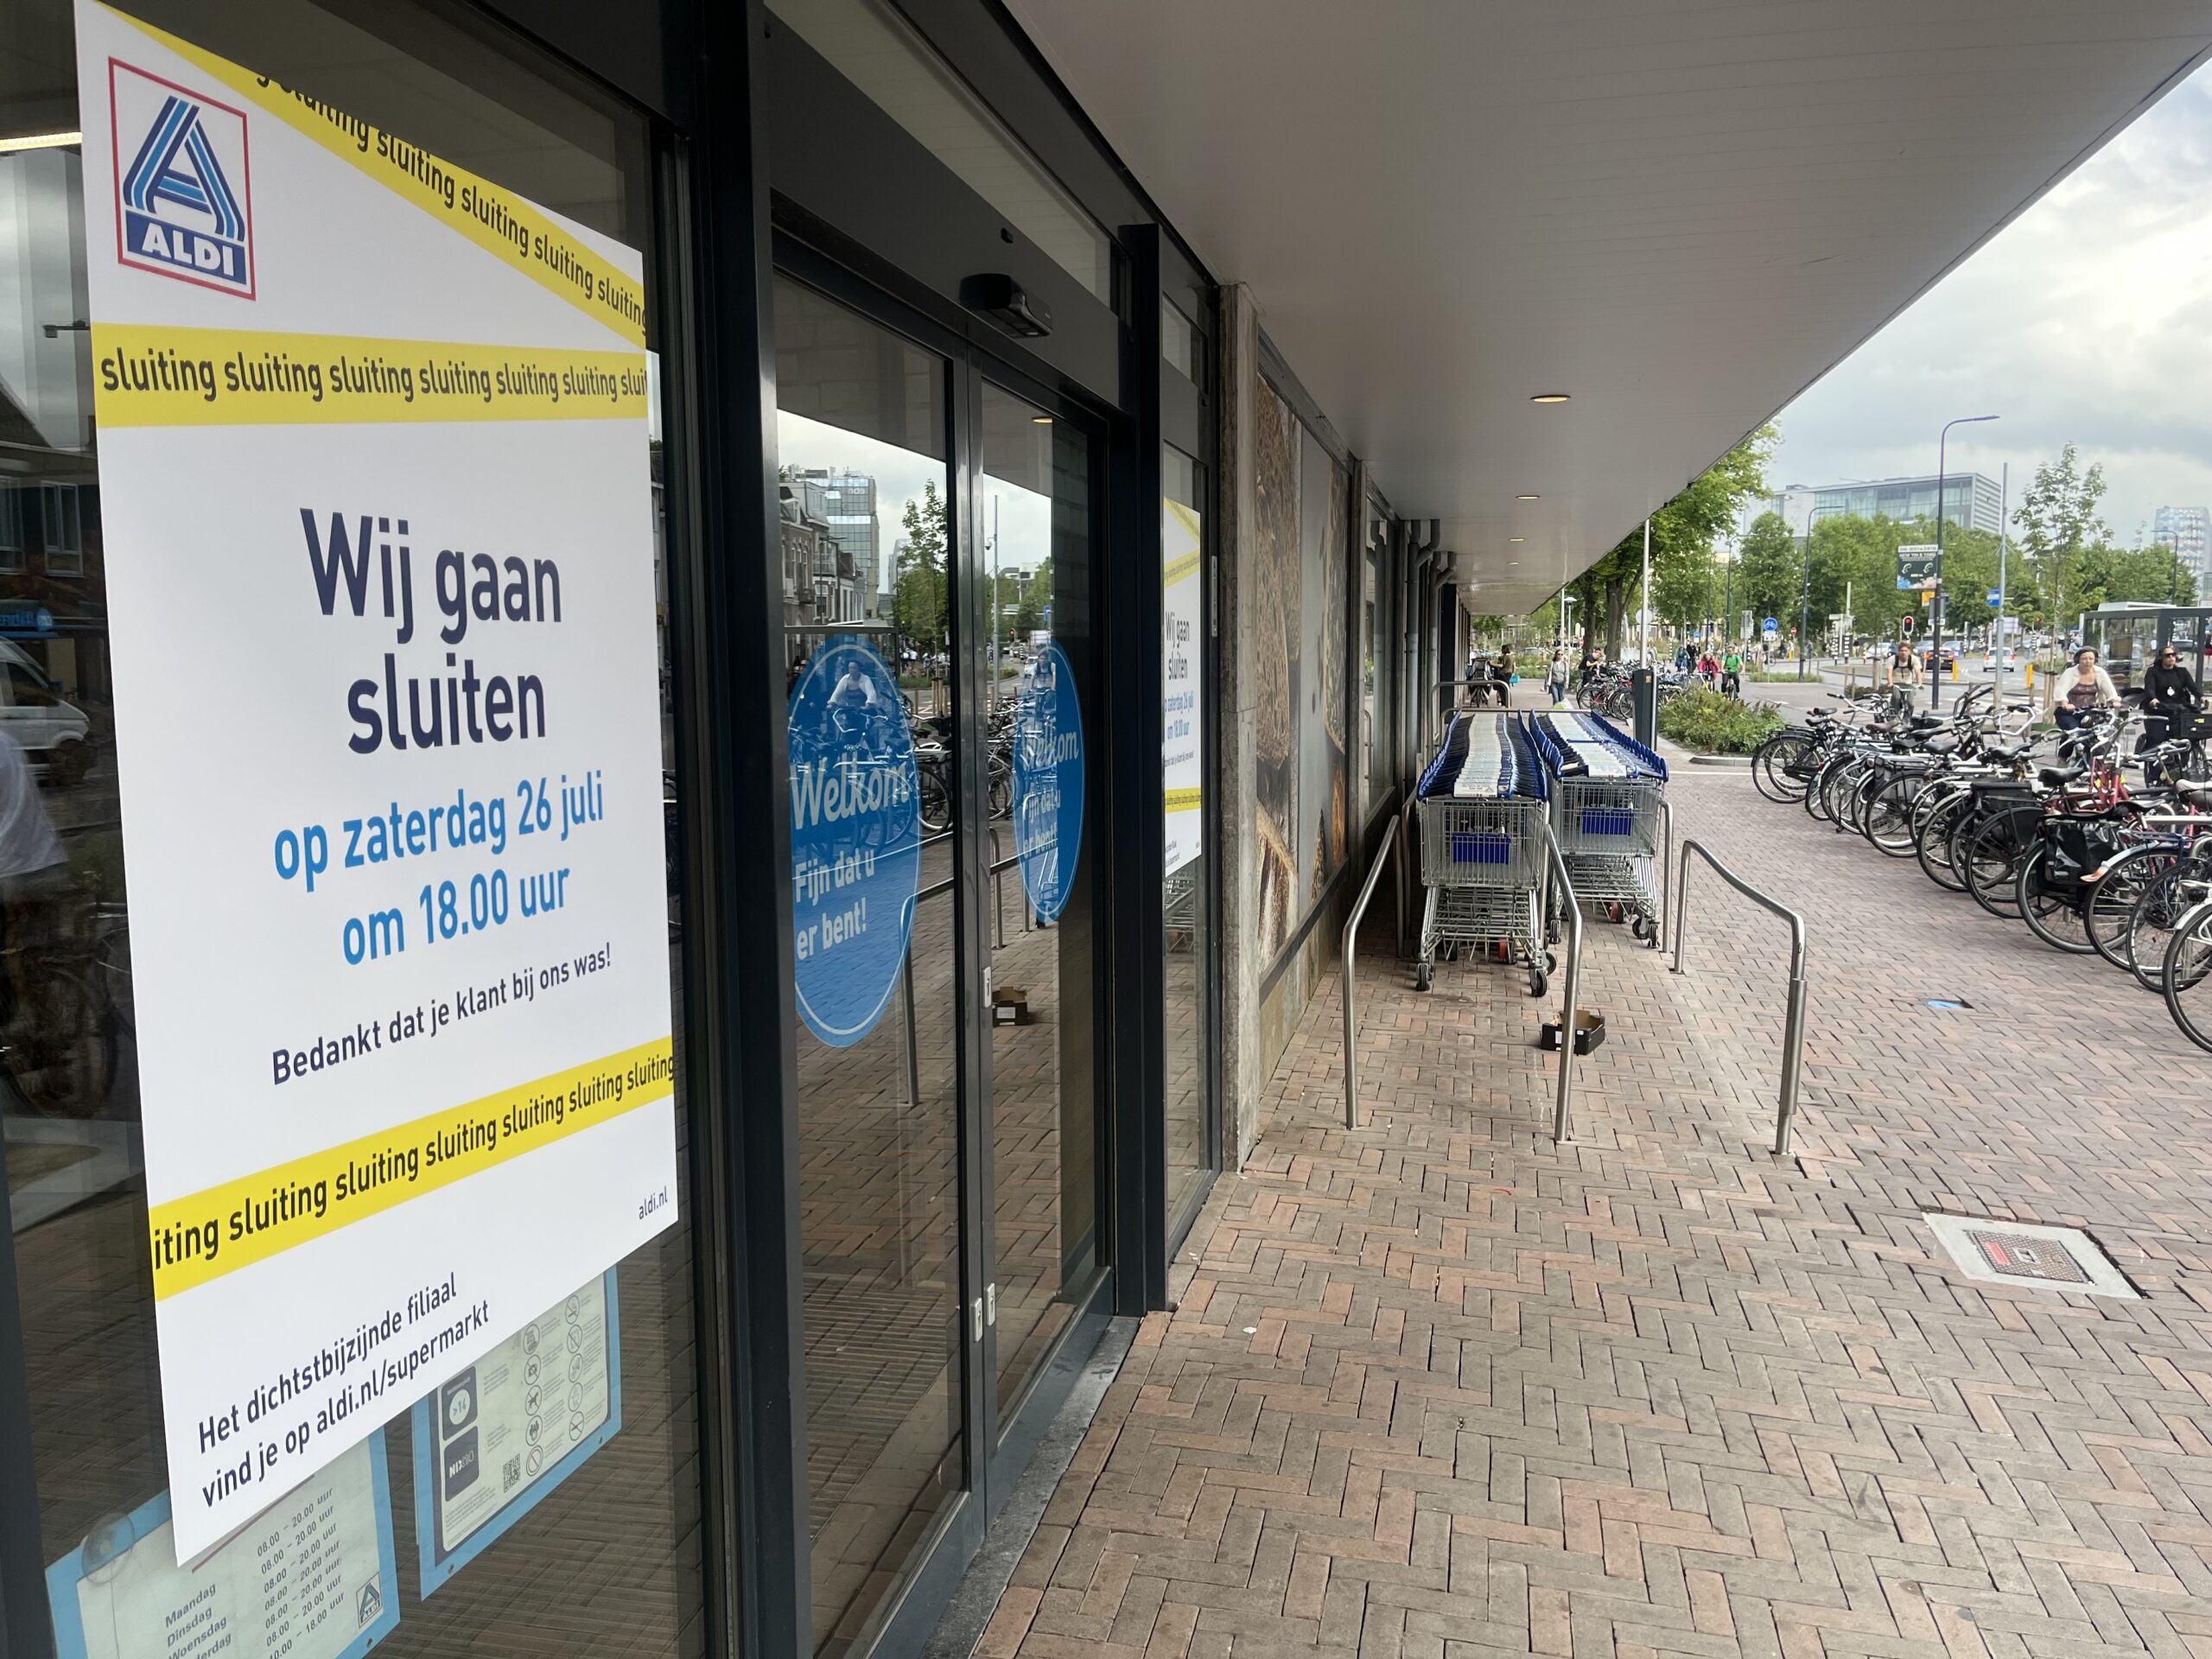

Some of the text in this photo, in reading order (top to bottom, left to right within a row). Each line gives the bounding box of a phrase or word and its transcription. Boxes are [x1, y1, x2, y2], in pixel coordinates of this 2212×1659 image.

[142, 222, 236, 277] ALDI
[461, 185, 529, 257] sluiting
[535, 234, 593, 300] sluiting
[101, 347, 217, 401] sluiting
[226, 351, 324, 403] sluiting
[330, 354, 414, 403] sluiting
[421, 359, 491, 403] sluiting
[496, 362, 559, 403] sluiting
[563, 365, 617, 403] sluiting
[300, 508, 562, 645] Wij gaan
[1168, 652, 1188, 680] sluiten
[1176, 620, 1190, 648] gaan
[347, 652, 545, 753] sluiten
[790, 752, 909, 830] Welkom
[274, 770, 603, 893] op zaterdag 26 juli
[795, 848, 874, 906] Fijn dat u
[343, 868, 570, 964] om 18.00 uur
[797, 898, 867, 960] er bent!
[273, 943, 612, 1084] Bedankt dat je klant bij ons was!
[155, 1219, 219, 1269] iting
[229, 1176, 327, 1241] sluiting
[335, 1145, 419, 1201] sluiting
[426, 1116, 497, 1166] sluiting
[502, 1091, 564, 1138] sluiting
[569, 1071, 623, 1113] sluiting
[639, 1185, 668, 1220] aldi.nl
[199, 1272, 457, 1454] Het dichtstbijzijnde filiaal
[201, 1458, 251, 1509] vind
[257, 1444, 278, 1483] je
[284, 1426, 310, 1462] op
[315, 1299, 489, 1436] aldi.nl/supermarkt
[257, 1531, 280, 1556] 08.00
[292, 1503, 314, 1528] 20.00
[317, 1488, 333, 1504] uur
[261, 1549, 283, 1574] 08.00
[296, 1521, 317, 1546] 20.00
[319, 1505, 334, 1522] uur
[264, 1568, 287, 1593] 08.00
[299, 1540, 321, 1565] 20.00
[322, 1522, 337, 1541] uur
[265, 1586, 288, 1611] 08.00
[300, 1557, 321, 1581] 20.00
[325, 1541, 340, 1558] uur
[165, 1584, 216, 1628] Maandag
[167, 1607, 213, 1647] Dinsdag
[265, 1604, 288, 1629] 08.00
[301, 1574, 322, 1599] 20.00
[325, 1558, 340, 1575] uur
[267, 1621, 289, 1647] 08.00
[302, 1592, 324, 1617] 20.00
[327, 1574, 341, 1592] uur
[305, 1610, 327, 1634] 18.00
[329, 1592, 345, 1610] uur
[168, 1617, 227, 1659] Woensdag
